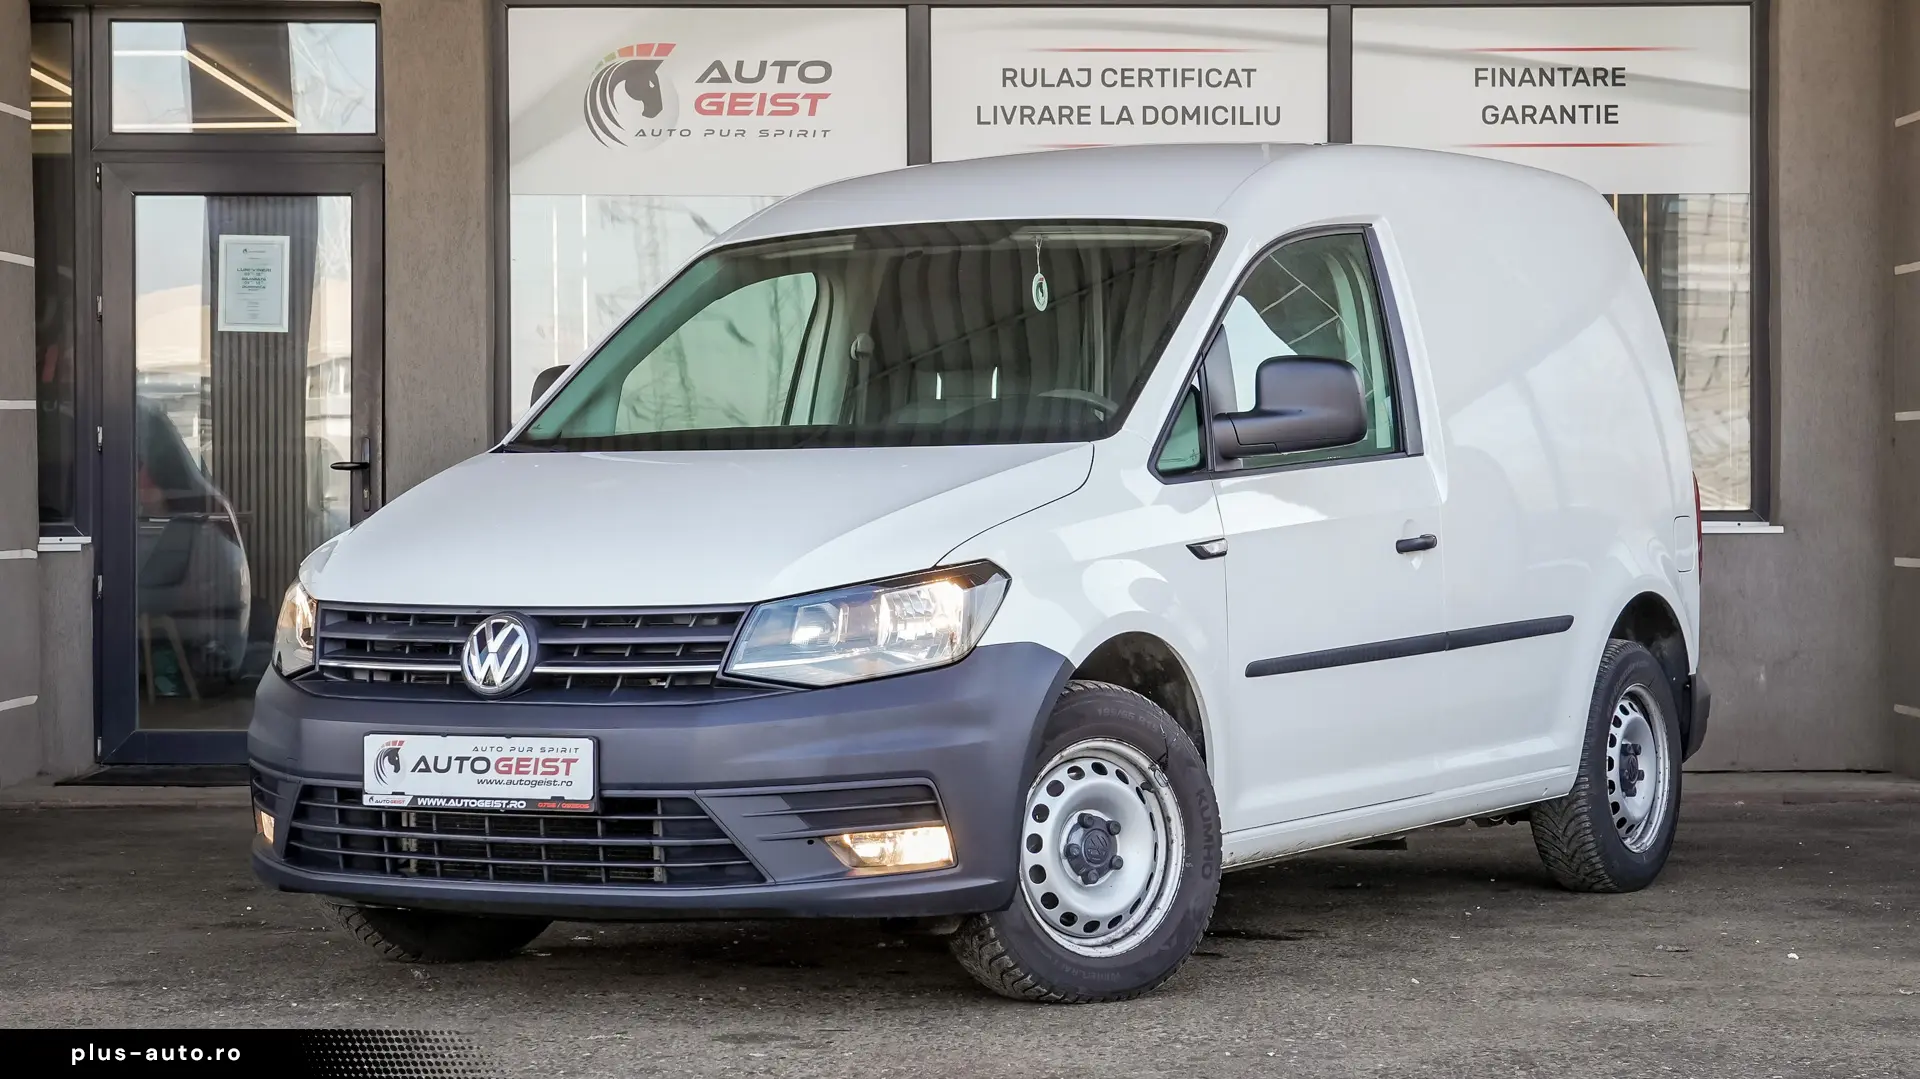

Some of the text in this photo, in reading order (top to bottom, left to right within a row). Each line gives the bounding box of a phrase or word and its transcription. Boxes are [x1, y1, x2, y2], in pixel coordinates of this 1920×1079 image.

[694, 60, 832, 84] AUTO
[1001, 67, 1257, 88] RULAJ CERTIFICAT
[1474, 66, 1626, 88] FINANTARE
[694, 92, 832, 117] GEIST
[1481, 104, 1619, 125] GARANTIE
[976, 105, 1281, 126] LIVRARE LA DOMICILIU
[634, 129, 832, 138] AUTO PUR SPIRIT
[472, 745, 580, 755] AUTO PUR SPIRIT
[476, 777, 573, 789] www.autogeist.ro
[417, 797, 527, 809] WWW.AUTOGEIST.RO
[1196, 787, 1215, 880] KUMHO
